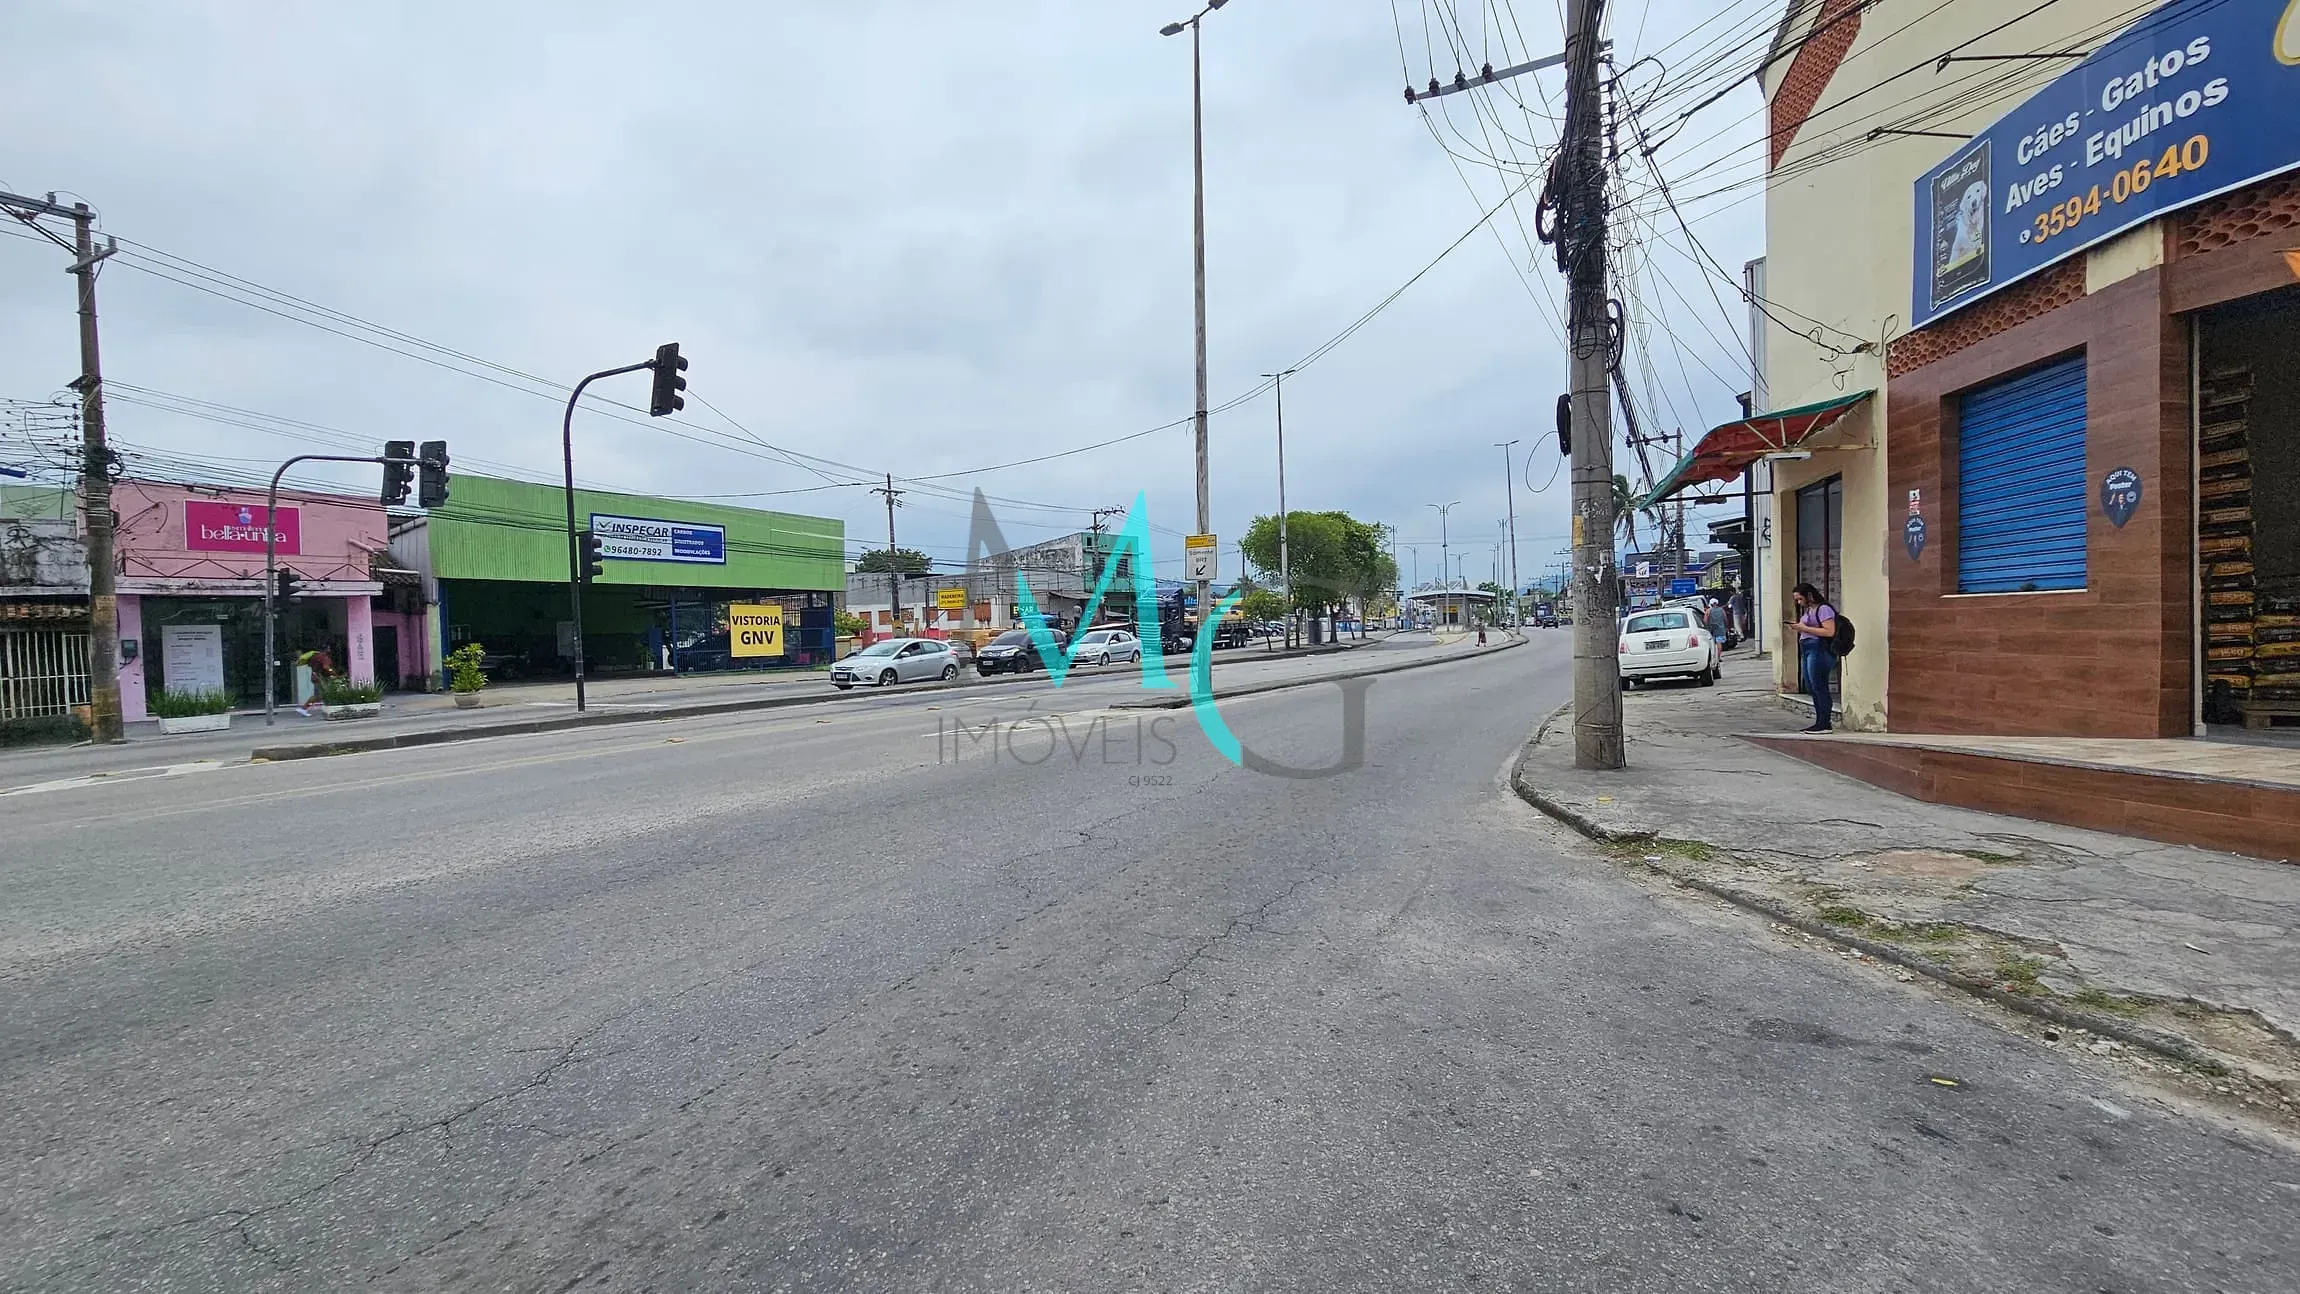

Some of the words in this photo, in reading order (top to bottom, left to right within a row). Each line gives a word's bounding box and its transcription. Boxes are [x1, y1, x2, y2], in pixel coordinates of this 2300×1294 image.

[2017, 111, 2080, 165] Cães
[2102, 36, 2211, 112] Gatos
[2005, 164, 2063, 214] Aves
[2086, 77, 2229, 168] Equinos
[2034, 134, 2209, 244] 3594-0640
[611, 523, 669, 537] INSPECAR
[611, 545, 662, 556] 96480-7892
[732, 615, 781, 626] VISTORIA
[740, 630, 774, 645] GNV
